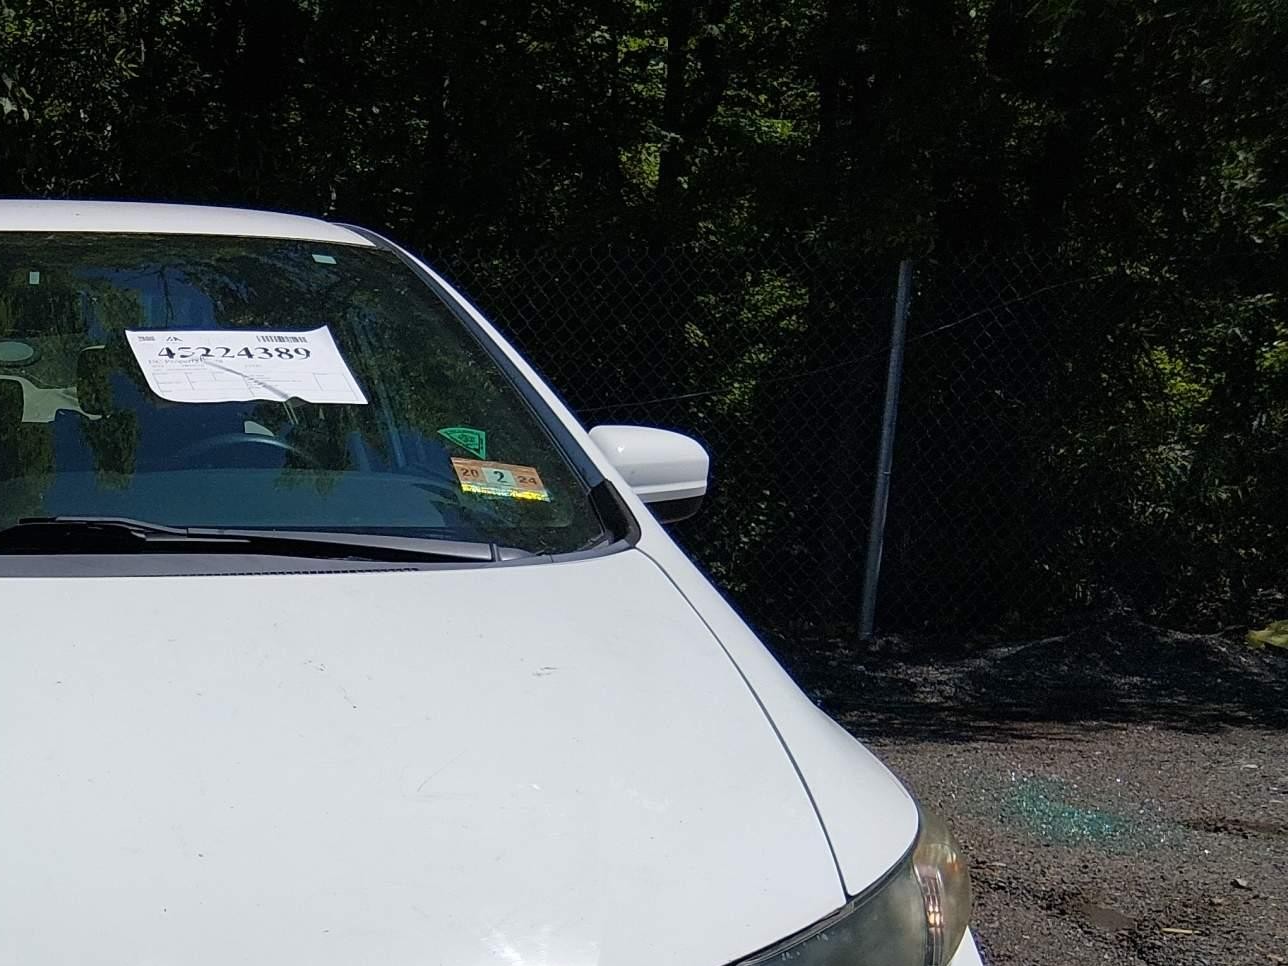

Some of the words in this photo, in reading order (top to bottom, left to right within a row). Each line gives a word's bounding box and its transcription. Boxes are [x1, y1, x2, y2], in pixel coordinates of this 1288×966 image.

[158, 345, 311, 361] 45224389
[460, 467, 479, 478] 20
[494, 470, 509, 483] 2
[517, 475, 537, 485] 24
